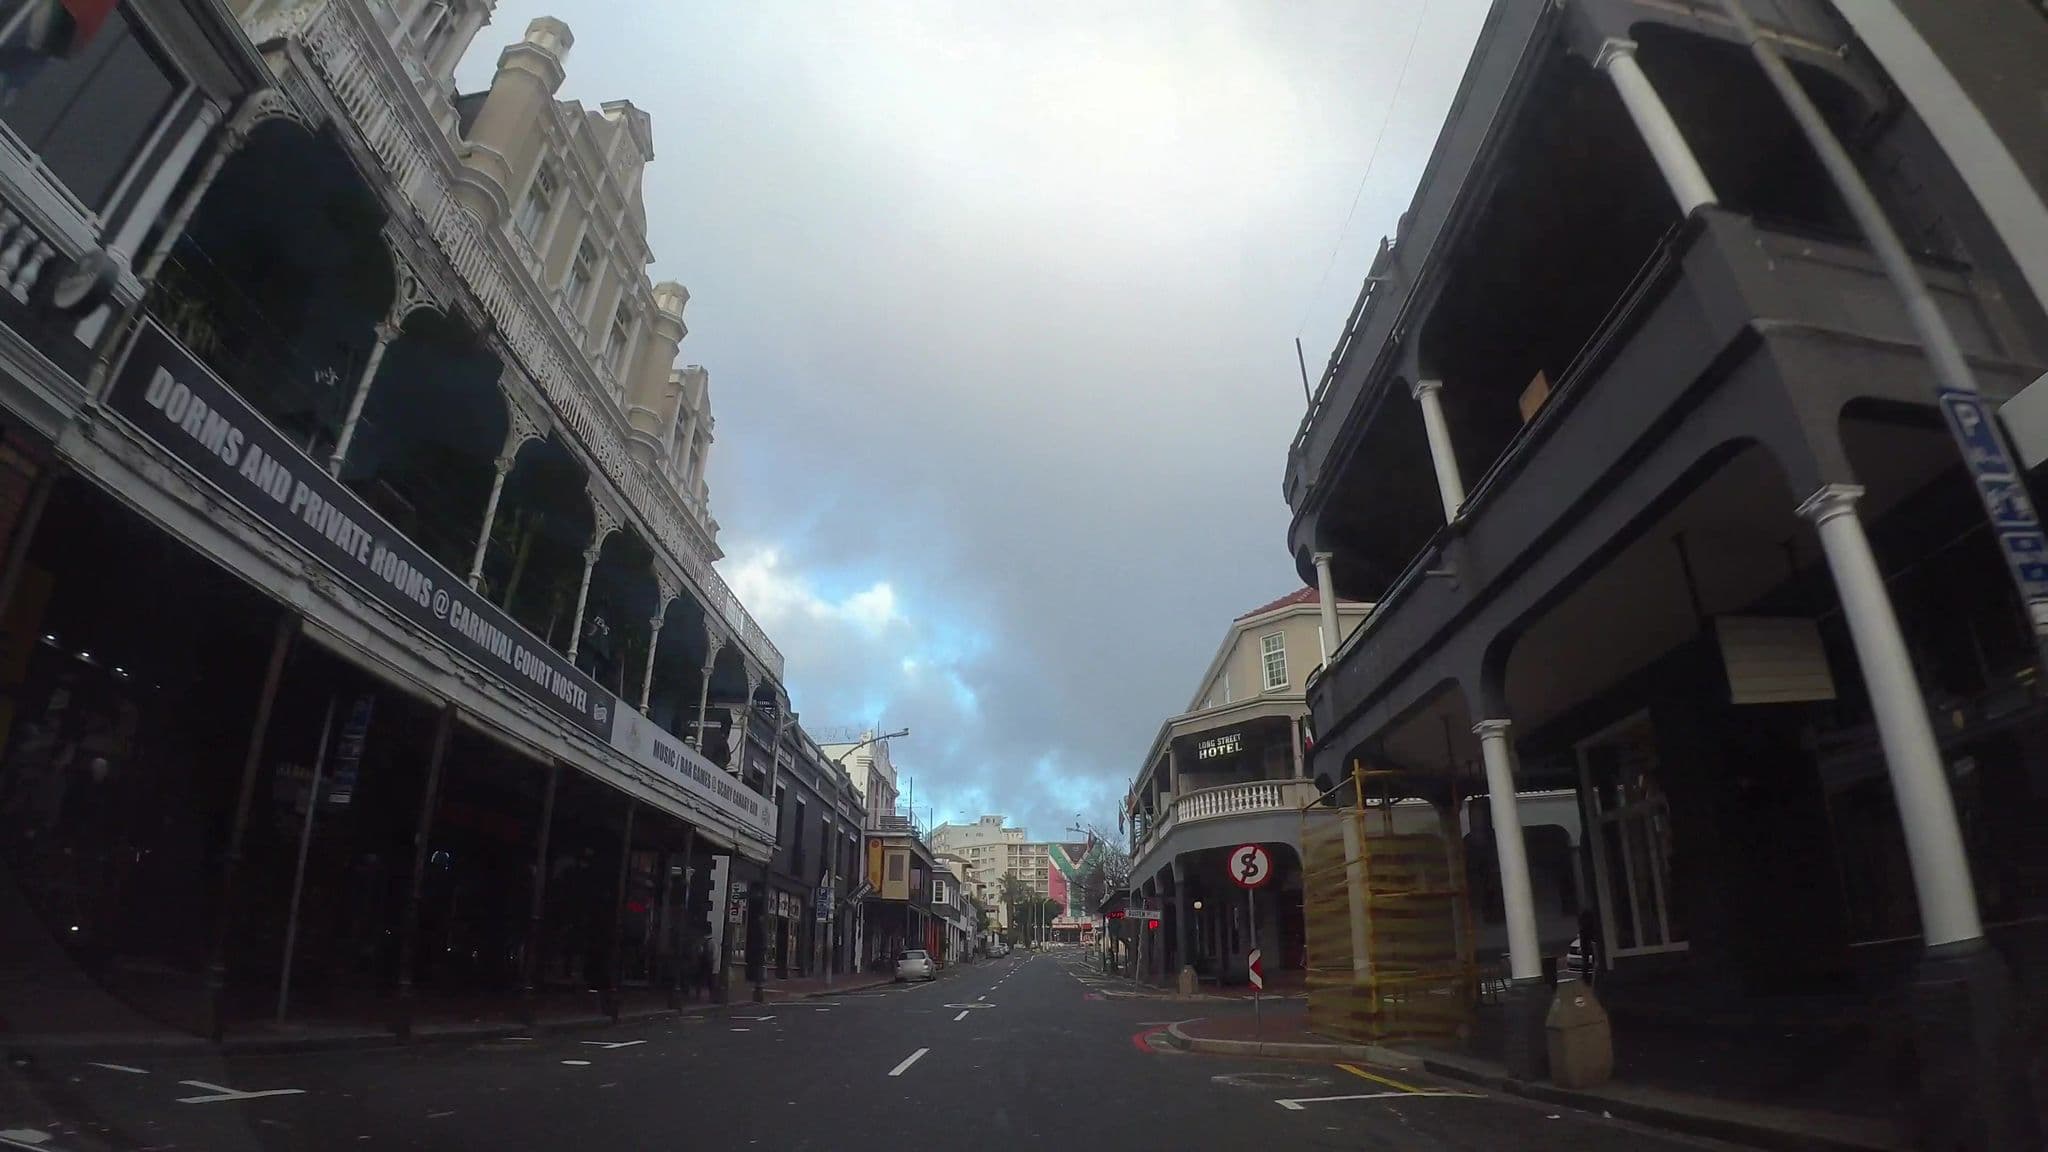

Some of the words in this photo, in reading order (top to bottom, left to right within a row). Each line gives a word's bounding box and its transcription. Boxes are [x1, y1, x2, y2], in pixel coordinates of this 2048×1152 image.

[145, 365, 245, 467] DORMS
[239, 443, 292, 504] AND
[290, 480, 373, 566] PRIVATE
[433, 589, 450, 619] @
[450, 599, 513, 665] CARNIVAL
[513, 645, 553, 690] COURT
[551, 671, 588, 714] HOSTEL
[1198, 739, 1216, 750] LONG
[1217, 733, 1241, 747] STREET
[1199, 742, 1243, 760] HOTEL
[653, 739, 676, 768] MUSIC
